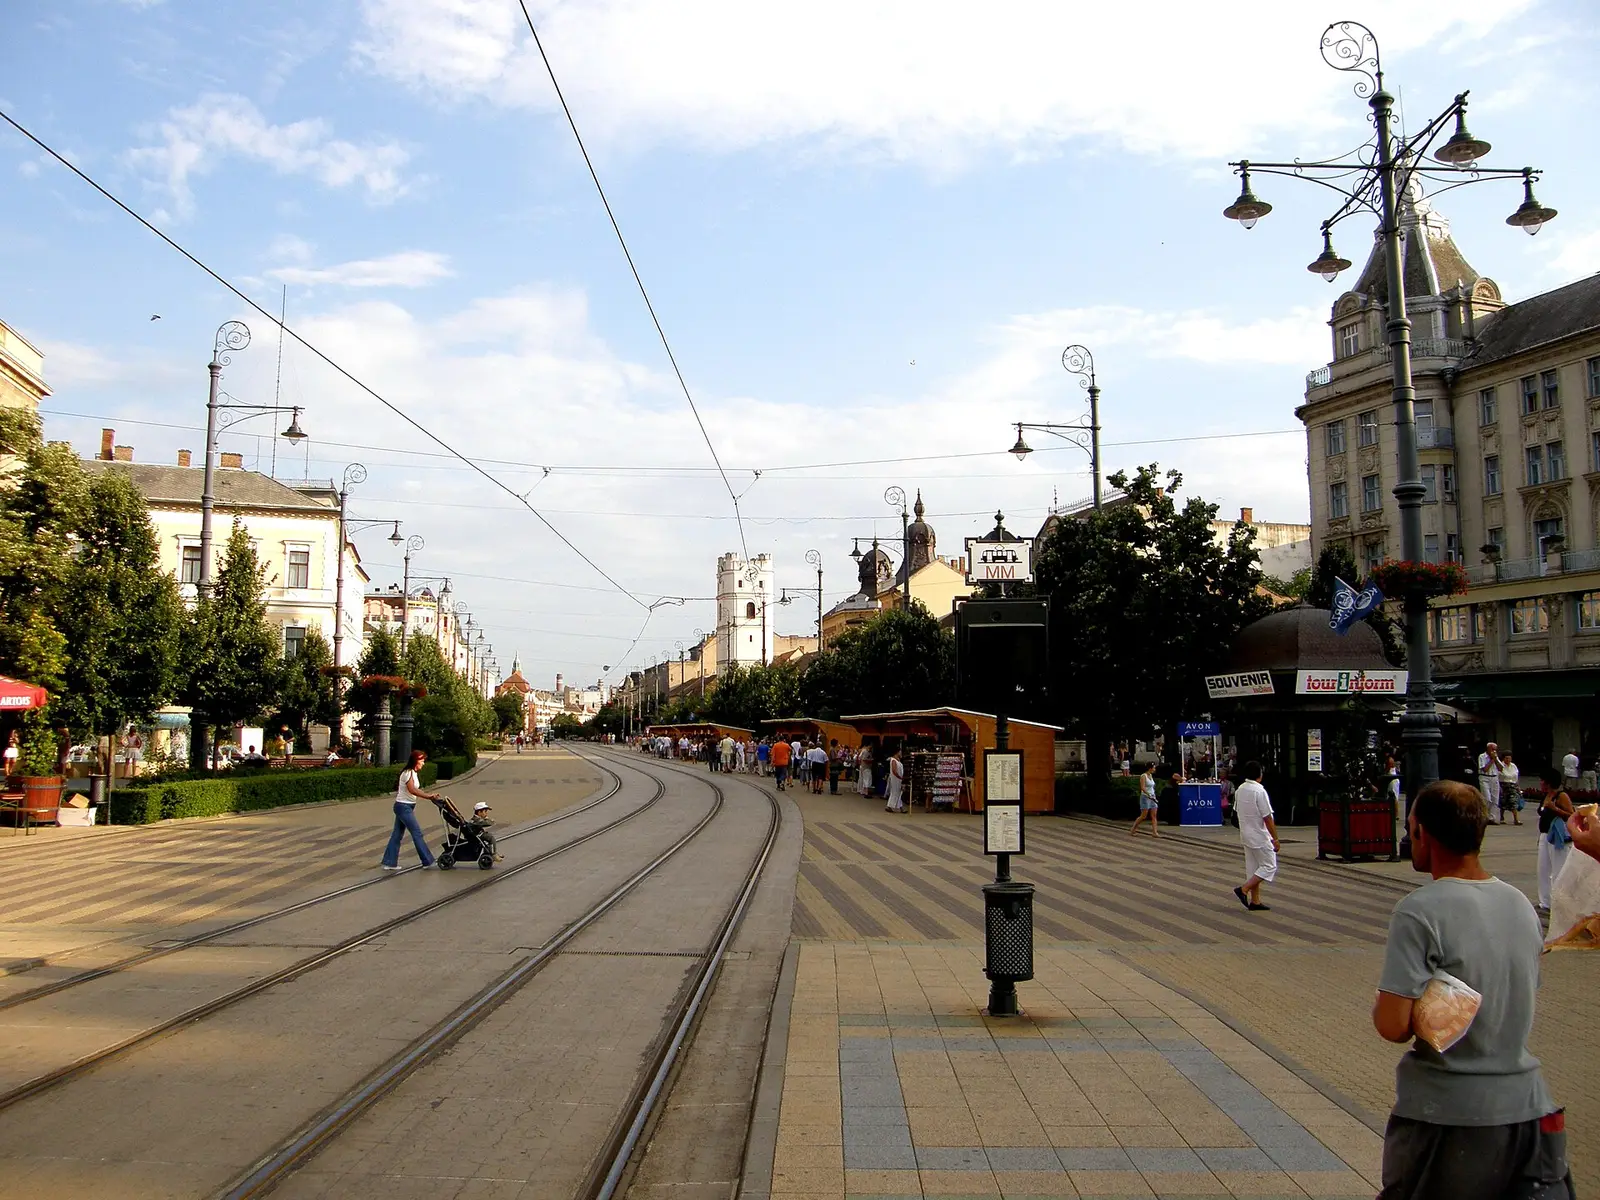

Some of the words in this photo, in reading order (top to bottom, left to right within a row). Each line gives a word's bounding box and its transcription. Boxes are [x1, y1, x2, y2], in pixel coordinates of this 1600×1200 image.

[985, 565, 1015, 579] MM
[1207, 673, 1271, 690] SOUVENIR
[1306, 672, 1395, 691] tourinform
[0, 696, 31, 706] ARTOIS
